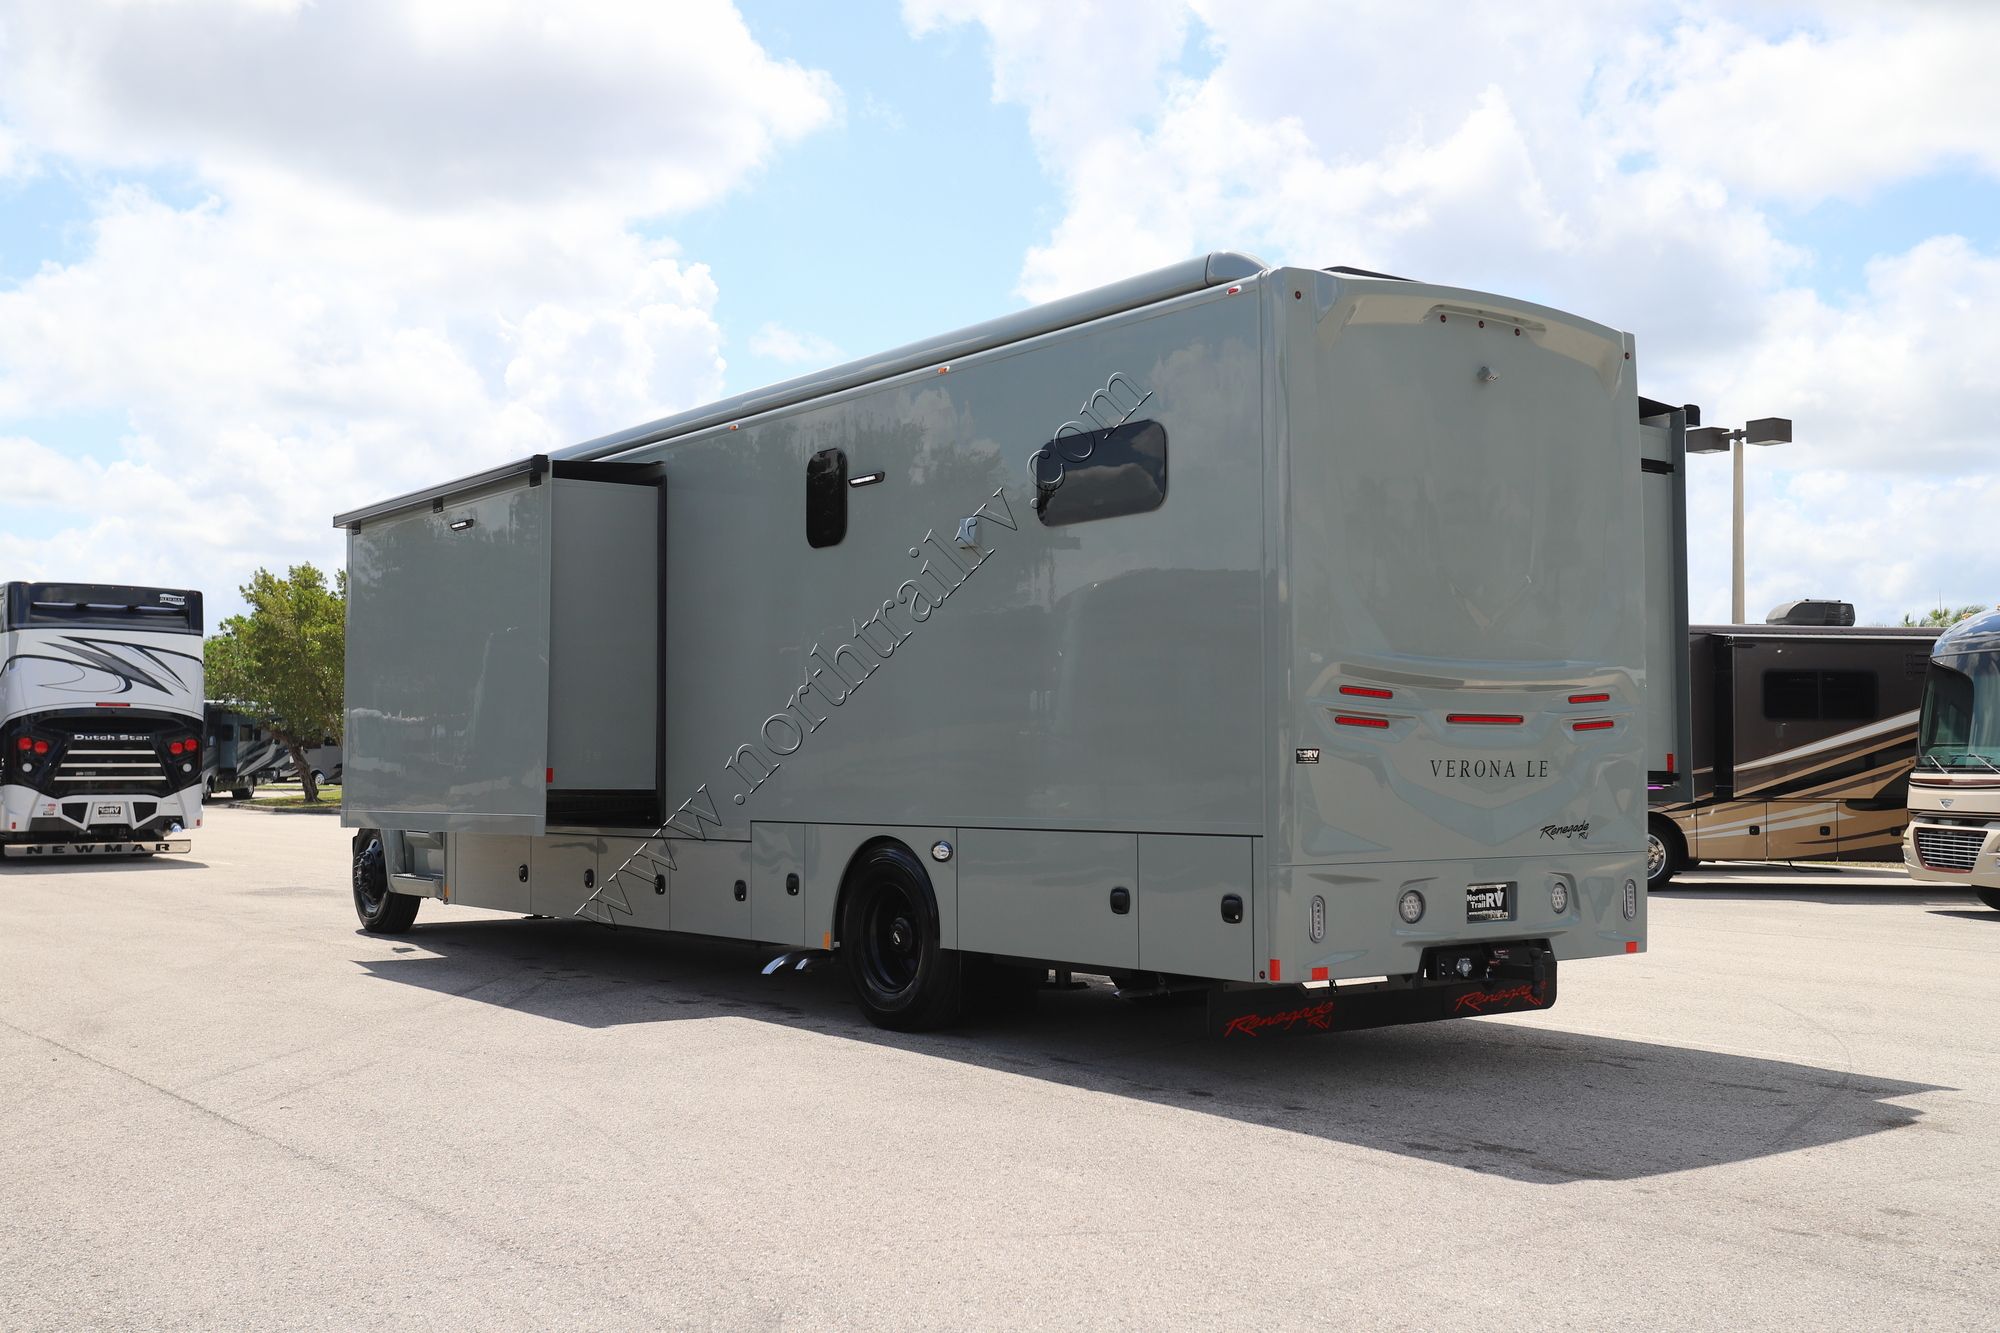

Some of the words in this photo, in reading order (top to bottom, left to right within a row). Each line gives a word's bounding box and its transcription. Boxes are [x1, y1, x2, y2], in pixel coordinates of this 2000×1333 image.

[1307, 749, 1319, 758] RV
[1430, 759, 1516, 778] VERONA
[1526, 760, 1549, 778] LE
[1539, 820, 1590, 841] Renegade
[26, 843, 170, 855] NEWMAR
[1466, 893, 1486, 902] North
[1470, 900, 1486, 909] Trail
[1485, 891, 1504, 908] RV
[1224, 1001, 1335, 1038] Renegade
